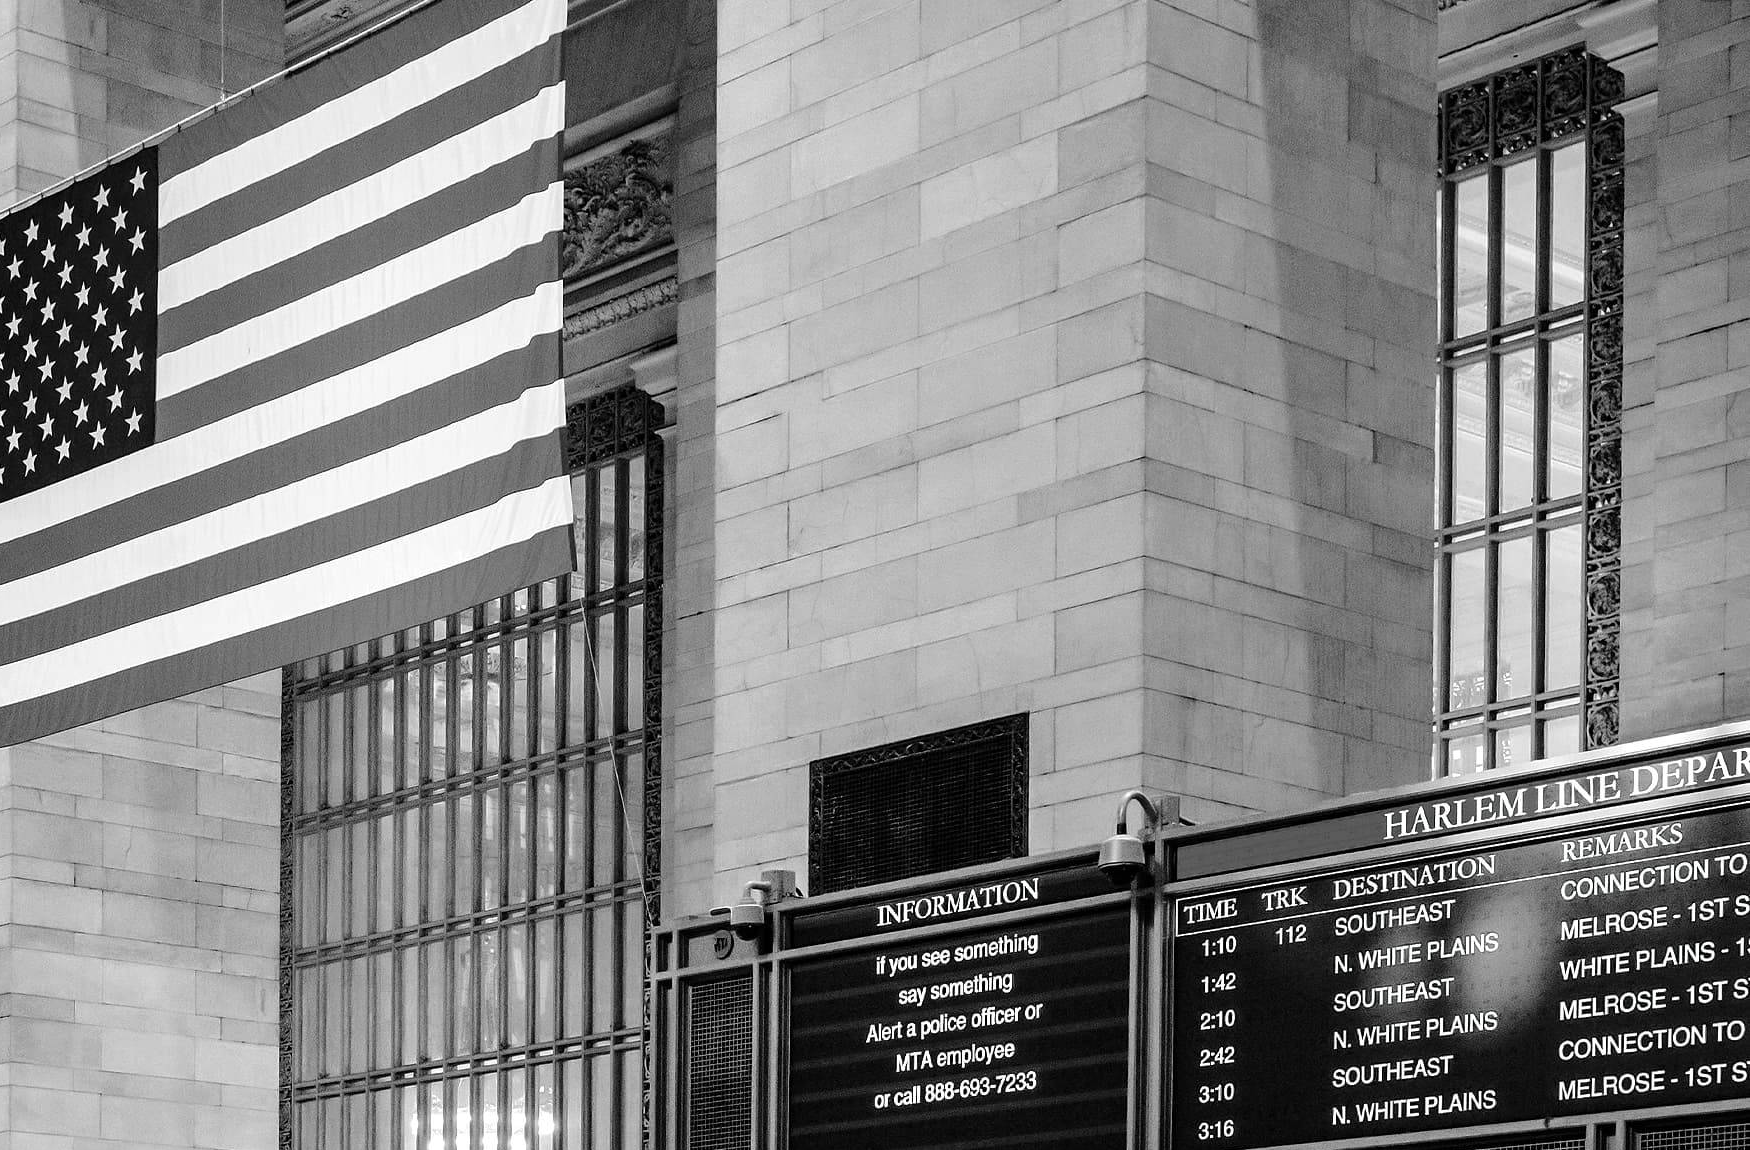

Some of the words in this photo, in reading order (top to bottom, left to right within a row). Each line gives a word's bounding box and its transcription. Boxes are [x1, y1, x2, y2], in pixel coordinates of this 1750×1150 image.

[1383, 788, 1527, 840] HARLEM
[1534, 771, 1621, 813] LINE
[1183, 898, 1238, 924] TIME
[1261, 886, 1308, 911] TRK
[1332, 854, 1496, 900] DESTINATION
[1560, 820, 1683, 863] REMARKS
[1560, 858, 1709, 901] CONNECTION
[1714, 853, 1748, 876] TO
[876, 877, 1039, 927] INFORMATION
[1335, 899, 1456, 936] SOUTHEAST
[1560, 906, 1668, 941] MELROSE
[1687, 897, 1730, 922] 1ST
[876, 955, 886, 975] if
[888, 954, 918, 978] you
[921, 949, 951, 968] see
[953, 933, 1039, 962] something
[1201, 935, 1237, 957] 1:10
[1275, 924, 1307, 945] 112
[1334, 954, 1353, 974] N.
[1358, 943, 1422, 970] WHITE
[1427, 932, 1499, 961] PLAINS
[1559, 952, 1630, 981] WHITE
[1636, 941, 1715, 971] PLAINS
[1736, 937, 1750, 957] 1
[898, 986, 927, 1007] say
[930, 972, 1013, 1000] something
[1201, 972, 1236, 993] 1:42
[1333, 977, 1455, 1012] SOUTHEAST
[1559, 988, 1667, 1021] MELROSE
[1686, 980, 1728, 1005] 1ST
[1733, 978, 1750, 999] S
[865, 1021, 903, 1043] Alert
[906, 1022, 917, 1038] a
[920, 1013, 967, 1040] police
[971, 1006, 1022, 1028] officer
[1024, 1003, 1044, 1020] or
[1200, 1009, 1236, 1031] 2:10
[1333, 1030, 1352, 1050] N.
[1357, 1020, 1421, 1046] WHITE
[1426, 1011, 1498, 1038] PLAINS
[896, 1050, 934, 1073] MTA
[936, 1043, 1016, 1069] employee
[1199, 1046, 1235, 1067] 2:42
[1558, 1024, 1707, 1061] CONNECTION
[1712, 1020, 1746, 1042] TO
[874, 1093, 891, 1109] or
[893, 1085, 921, 1107] call
[924, 1070, 1037, 1103] 888-693-7233
[1332, 1054, 1454, 1088] SOUTHEAST
[1558, 1070, 1666, 1101] MELROSE
[1685, 1063, 1727, 1087] 1ST
[1731, 1060, 1750, 1083] S
[1198, 1083, 1235, 1104] 3:10
[1332, 1106, 1351, 1125] N.
[1355, 1097, 1420, 1123] WHITE
[1424, 1089, 1496, 1116] PLAINS
[1198, 1119, 1234, 1140] 3:16
